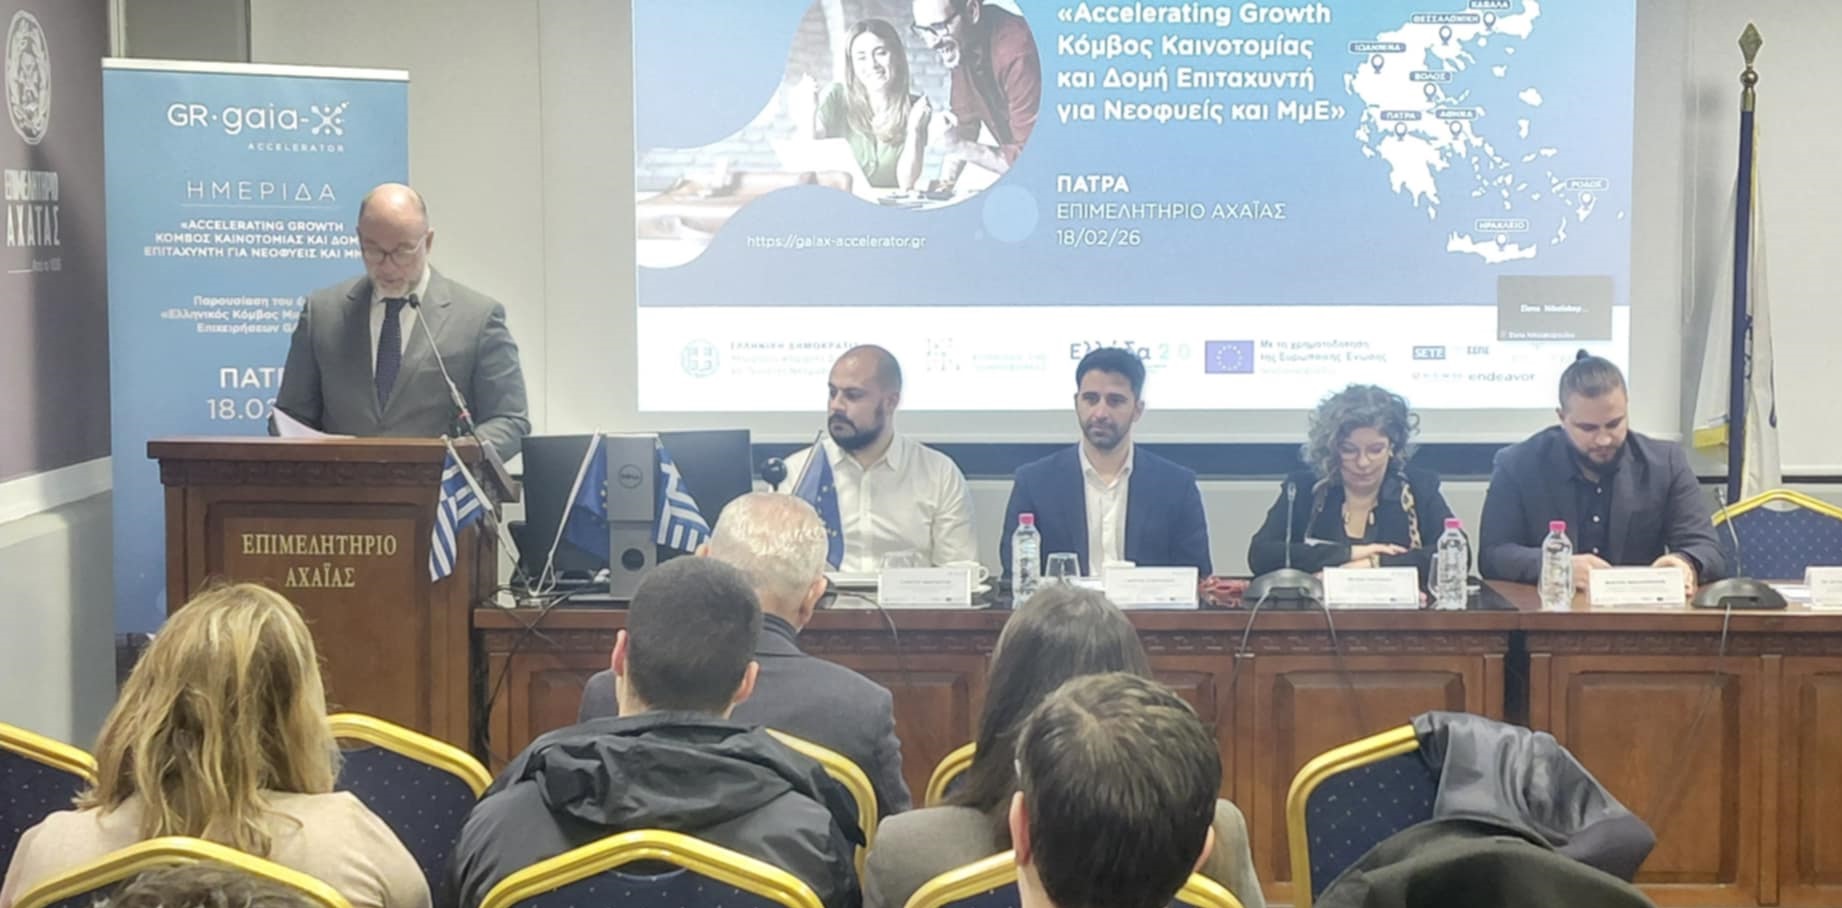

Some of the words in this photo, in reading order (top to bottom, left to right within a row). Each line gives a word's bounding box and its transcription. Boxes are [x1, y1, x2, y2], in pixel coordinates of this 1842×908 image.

[1057, 2, 1231, 27] «Accelerating
[1239, 3, 1331, 23] Growth
[1057, 34, 1153, 58] Κόμβος
[1162, 34, 1314, 59] Καινοτομίας
[1057, 71, 1095, 88] και
[1103, 66, 1168, 92] Δομή
[1176, 67, 1315, 92] Επιταχυντή
[1057, 103, 1096, 124] για
[1104, 99, 1223, 125] Νεοφυείς
[1231, 103, 1269, 120] και
[1277, 101, 1346, 124] ΜμΕ»
[248, 143, 344, 153] ACCELERATOR
[186, 181, 336, 201] ΗΜΕΡΙΔΑ
[1057, 175, 1130, 193] ΠΑΤΡΑ
[1057, 203, 1206, 220] ΕΠΙΜΕΛΗΤΗΡΙΟ
[1212, 200, 1287, 220] ΑΧΑΪΑΣ
[181, 219, 284, 231] «ACCELERATING
[288, 221, 344, 232] GROWTH
[155, 233, 211, 243] ΚΟΜΒΟΣ
[215, 234, 304, 244] ΚΑΙΝΟΤΟΜΙΑΣ
[307, 235, 328, 245] ΚΑΙ
[747, 234, 927, 249] https://galax-accelerator.gr
[1056, 229, 1141, 247] 18/02/26
[143, 246, 224, 257] ΕΠΙΤΑΧΥΝΤΗ
[227, 248, 248, 257] ΓΙΑ
[252, 248, 317, 258] ΝΕΟΦΥΕΙΣ
[320, 249, 341, 259] ΚΑΙ
[193, 295, 269, 308] Παρουσίαση
[272, 297, 294, 306] του
[232, 308, 279, 320] Κόμβος
[1468, 371, 1536, 382] endeavor
[242, 534, 397, 555] ΕΠΙΜΕΛΗΤΗΡΙΟ
[285, 562, 355, 587] ΑΧΑΪΑΣ
